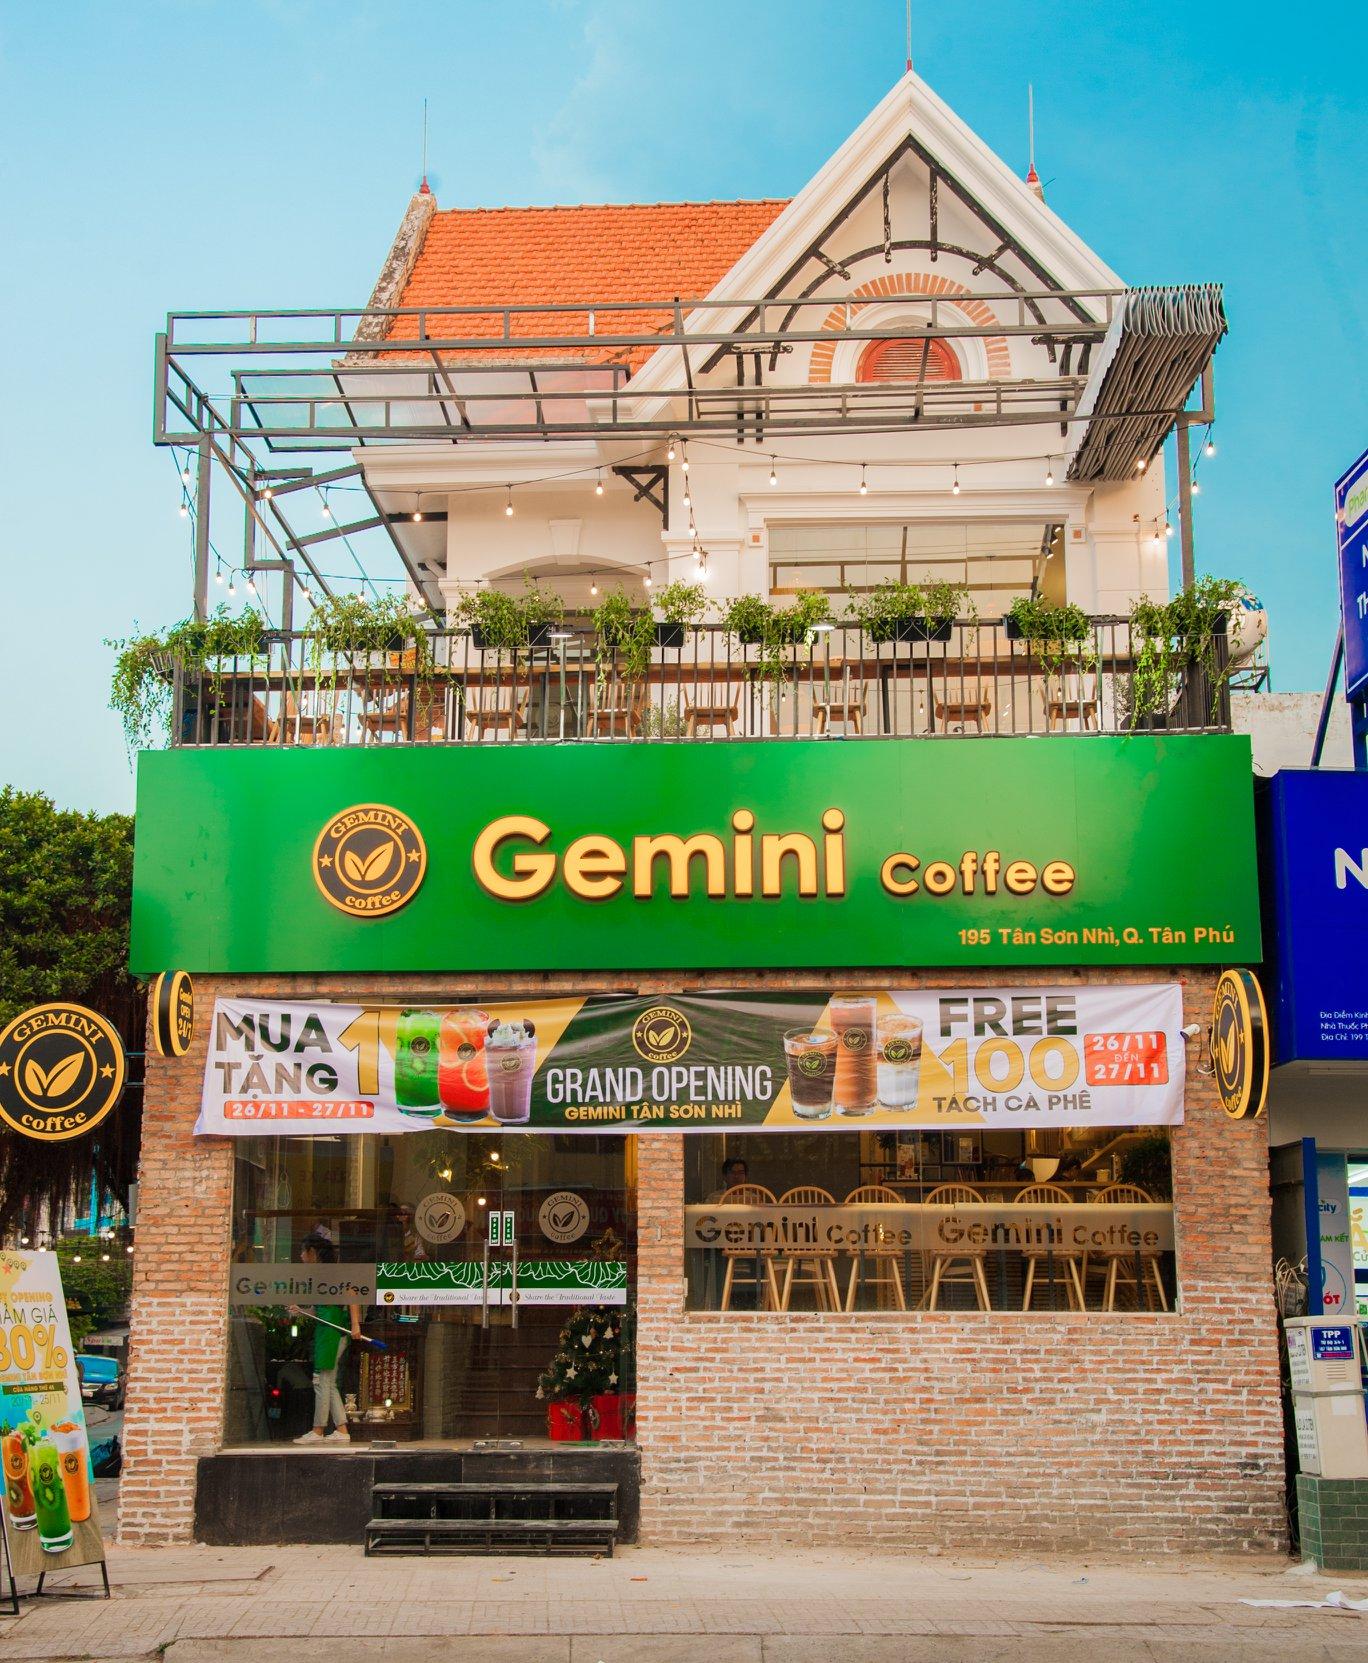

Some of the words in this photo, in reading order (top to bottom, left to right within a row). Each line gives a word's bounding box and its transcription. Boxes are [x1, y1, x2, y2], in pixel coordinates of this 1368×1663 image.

[330, 810, 409, 839] GEMINI
[472, 808, 845, 901] Gemini
[881, 851, 1076, 897] Coffee
[345, 890, 402, 910] coffee
[957, 929, 991, 945] 195
[998, 927, 1036, 945] Tân
[1040, 928, 1078, 945] Sơn
[1149, 926, 1186, 944] Tân
[1194, 923, 1235, 943] Phú
[641, 1009, 683, 1025] GEMINI
[938, 995, 1078, 1037] FREE
[12, 1013, 105, 1045] GEMINI
[178, 1018, 192, 1040] 24/7
[215, 1011, 333, 1053] MUA
[337, 1010, 381, 1096] 1
[1093, 1034, 1158, 1051] 26/11
[648, 1051, 678, 1061] coffee
[936, 1036, 1080, 1094] 100
[214, 1053, 338, 1100] TẶNG
[1094, 1063, 1159, 1080] 27/11
[546, 1067, 643, 1103] GRAND
[652, 1065, 773, 1102] OPENING
[232, 1102, 290, 1117] 26/11
[311, 1101, 368, 1117] 27/11
[564, 1106, 626, 1120] GEMINI
[631, 1102, 664, 1119] TÂN
[669, 1102, 706, 1119] SƠN
[711, 1100, 742, 1118] NHÌ
[932, 1091, 997, 1113] TÁCH
[1004, 1092, 1043, 1112] CÀ
[1048, 1089, 1091, 1111] PHÊ
[21, 1111, 87, 1131] coffee
[547, 1195, 583, 1207] GEMINI
[694, 1214, 817, 1244] Gemini
[826, 1223, 912, 1246] Coffee
[937, 1214, 1063, 1245] Gemini
[236, 1275, 315, 1297] Gemini
[317, 1280, 370, 1297] Coffee
[31, 1304, 58, 1324] GIÁ
[1321, 1330, 1341, 1338] TPP
